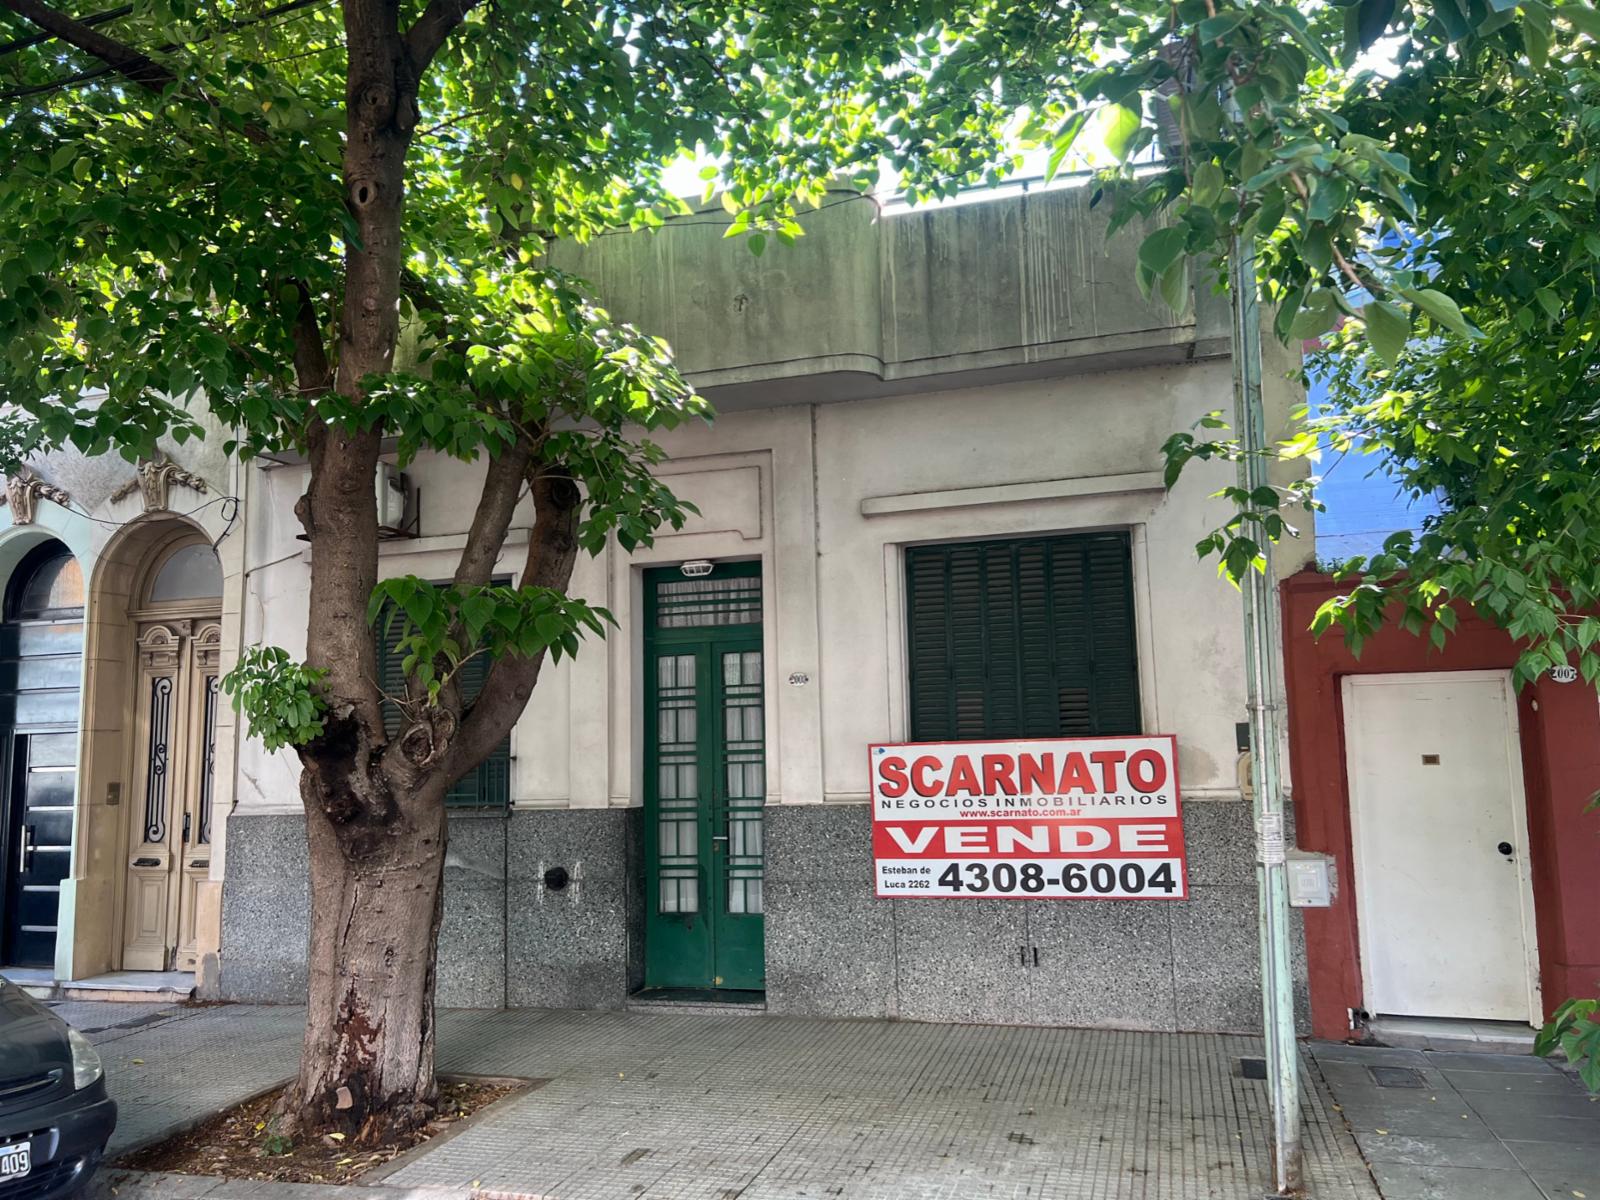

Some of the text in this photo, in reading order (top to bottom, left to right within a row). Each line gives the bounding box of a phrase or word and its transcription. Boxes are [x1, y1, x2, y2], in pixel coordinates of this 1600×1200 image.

[878, 748, 1167, 798] SCARNATO
[881, 795, 1168, 809] NEGOCIOS INMOBILIARIOS
[960, 807, 1082, 817] www.scarnato.com.ar
[885, 824, 1169, 854] VENDE
[882, 866, 931, 874] Esteban de
[938, 862, 1176, 893] 4308-6004
[884, 880, 930, 889] Luca 2262
[1, 1152, 29, 1174] 409
